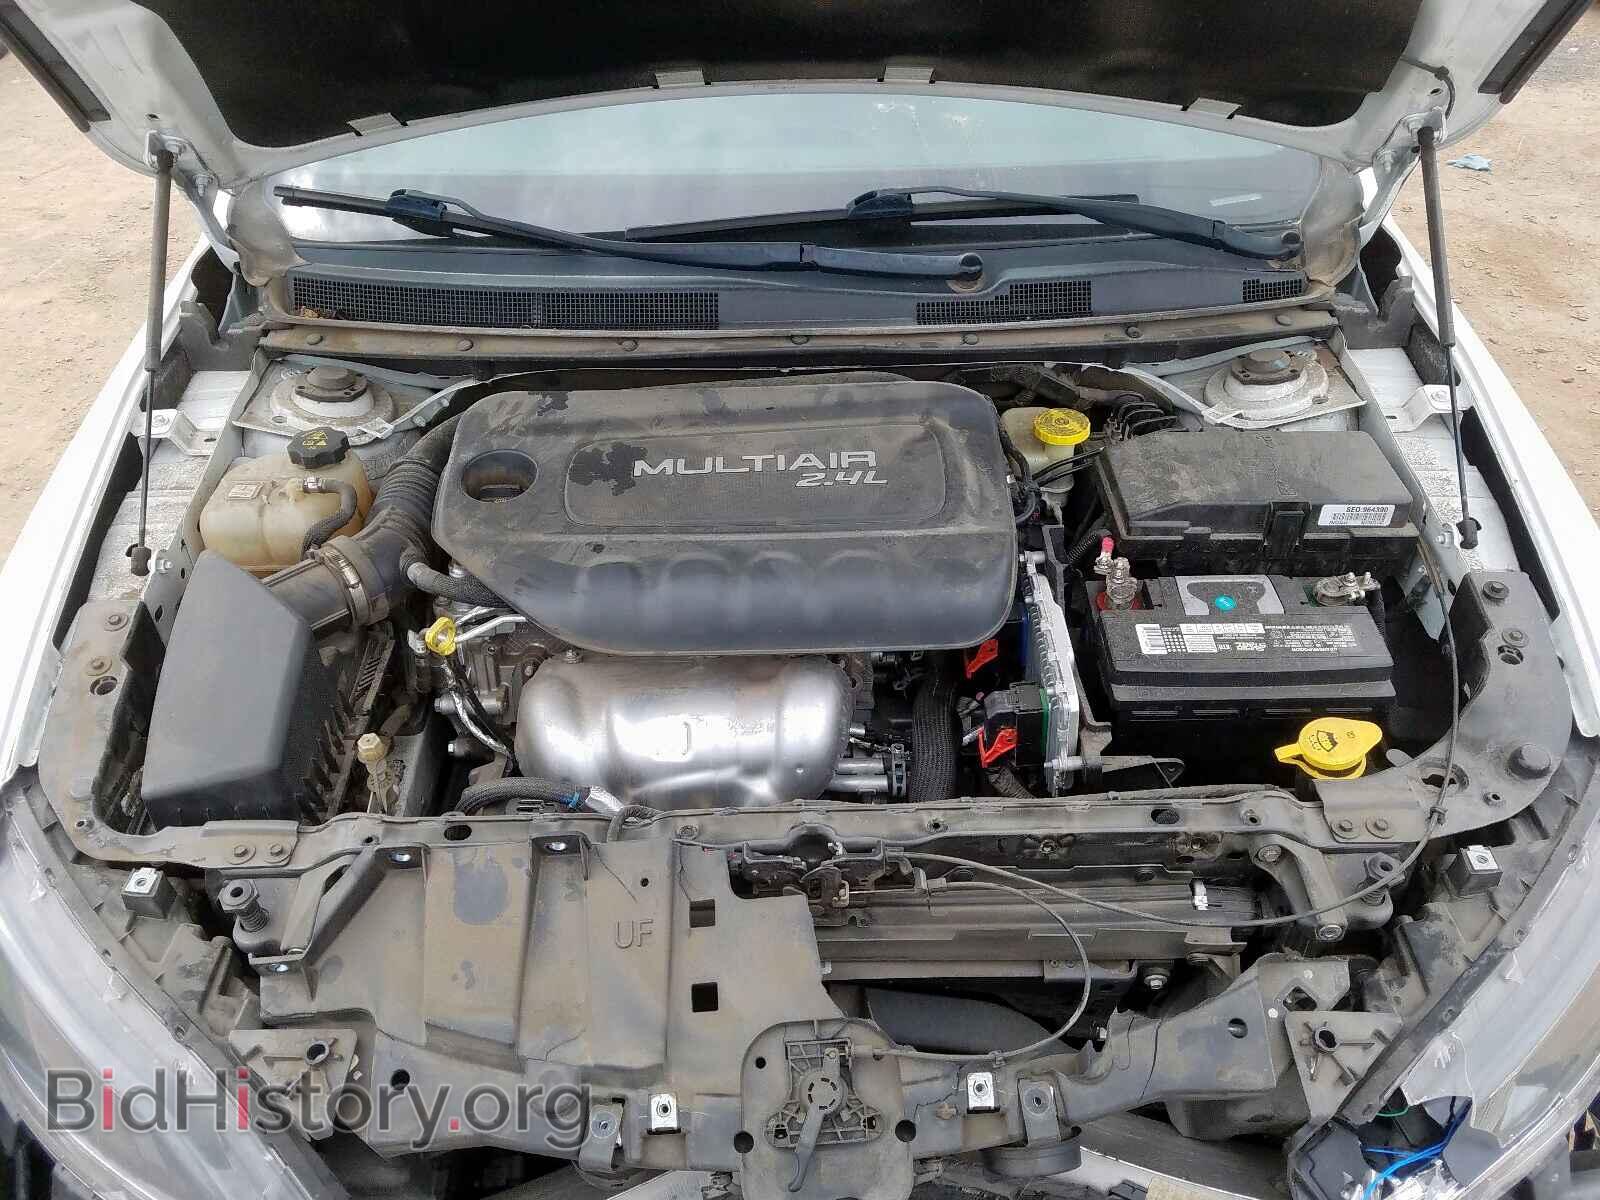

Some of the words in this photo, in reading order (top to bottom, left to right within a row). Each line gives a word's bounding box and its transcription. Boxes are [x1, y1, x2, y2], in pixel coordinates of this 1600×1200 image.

[633, 450, 877, 477] MULTIAIR
[795, 470, 889, 488] 2.4L
[615, 918, 654, 949] UF
